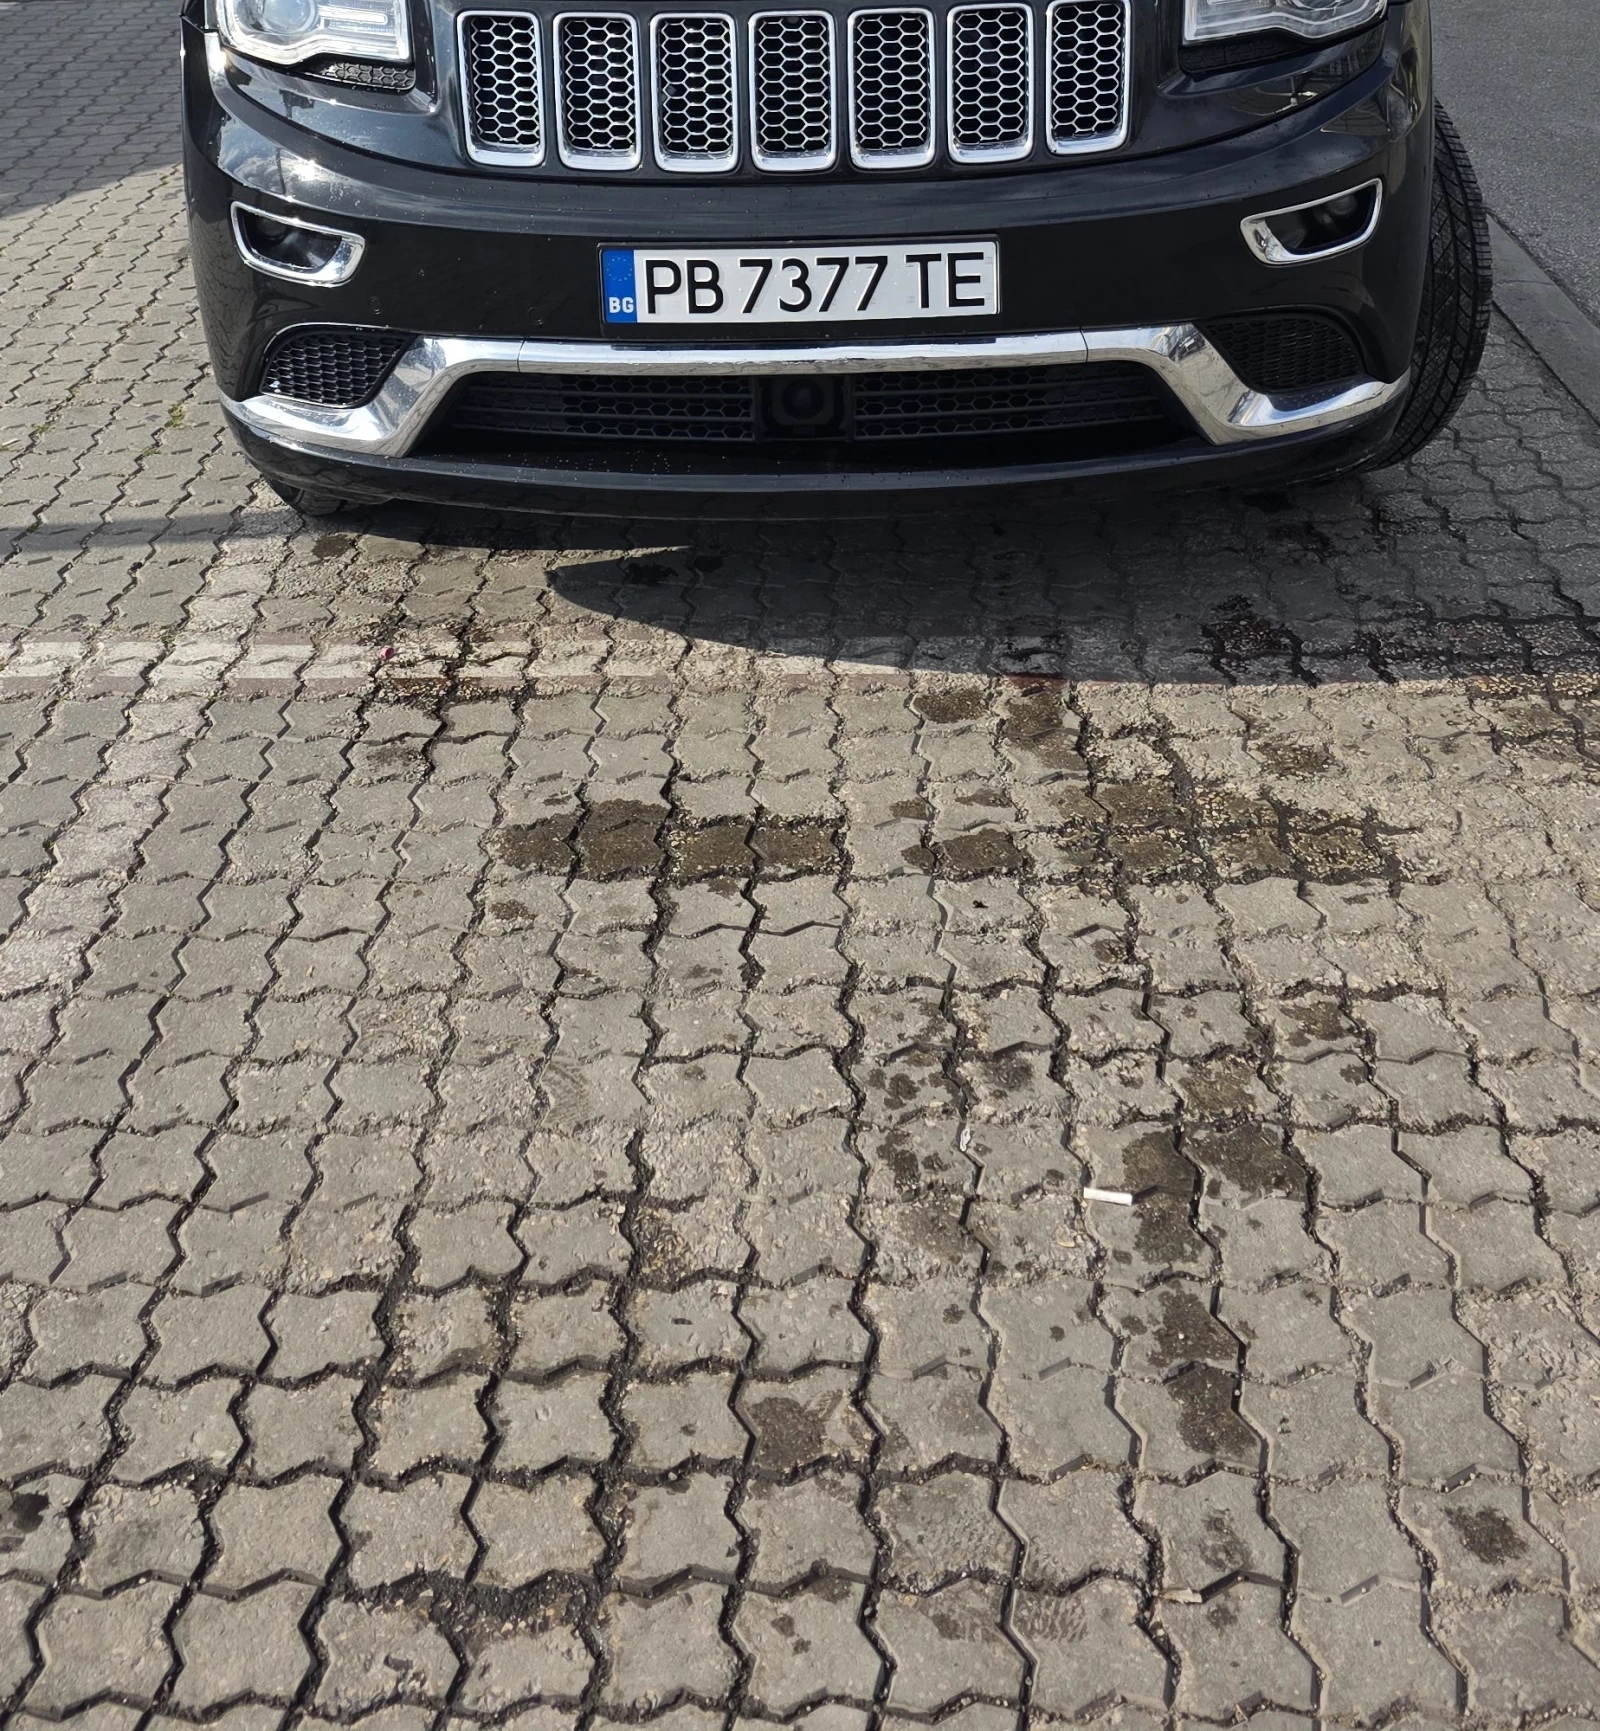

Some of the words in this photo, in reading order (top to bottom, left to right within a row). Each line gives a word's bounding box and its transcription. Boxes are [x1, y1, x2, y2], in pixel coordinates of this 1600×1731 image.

[645, 259, 724, 314] PB
[739, 256, 888, 314] 7377
[905, 252, 985, 309] TE
[609, 297, 634, 314] BG
